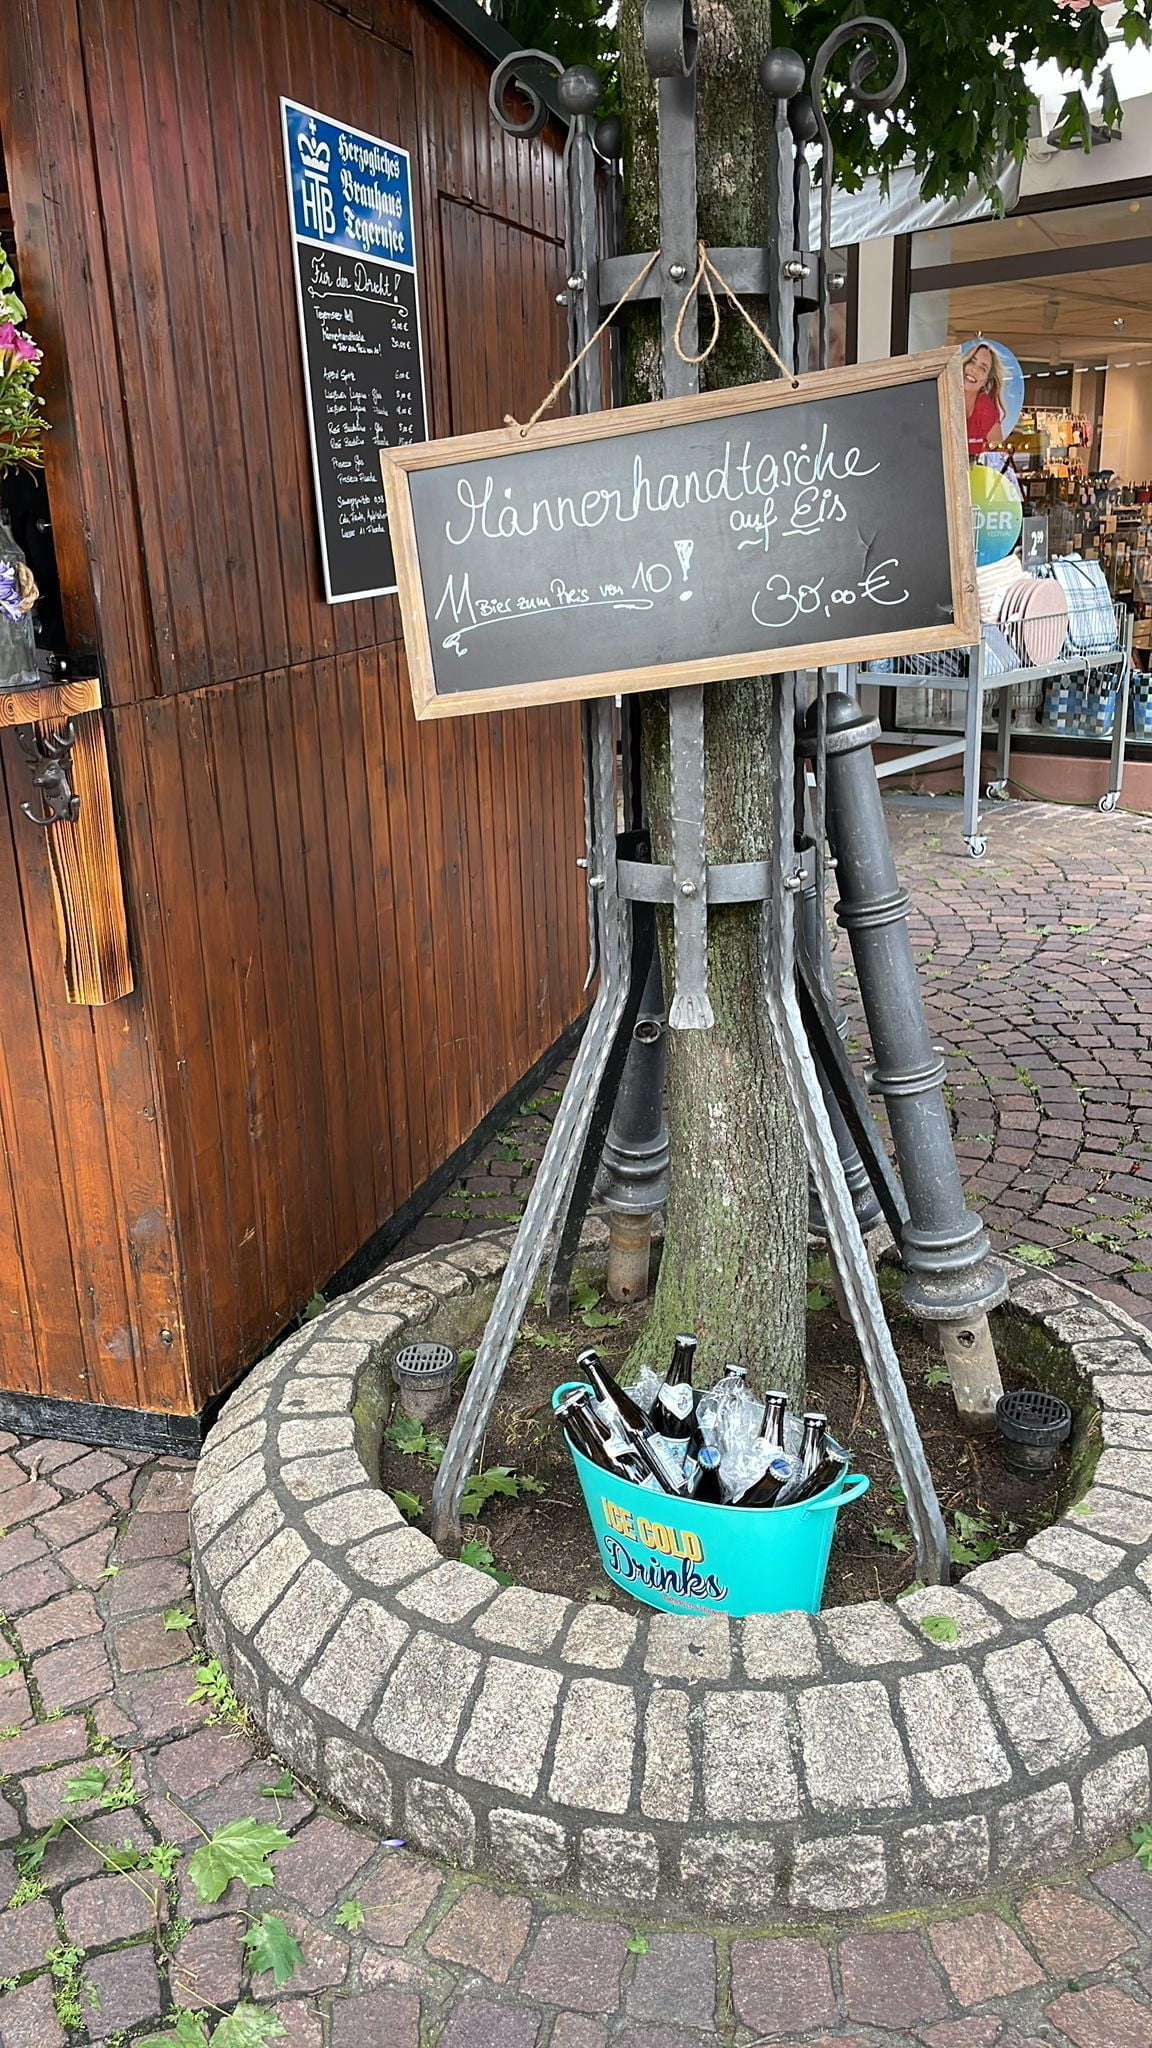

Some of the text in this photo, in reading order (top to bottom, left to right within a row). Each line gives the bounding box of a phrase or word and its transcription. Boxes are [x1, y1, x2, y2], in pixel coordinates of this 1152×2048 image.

[338, 133, 400, 182] Herzogliches
[340, 168, 403, 219] Brauhaus
[343, 205, 405, 260] Tegernsee
[730, 487, 847, 551] auf Eis
[435, 573, 477, 623] 11
[476, 599, 511, 617] Bier
[516, 596, 550, 609] zum
[551, 578, 589, 602] Preis
[599, 584, 623, 597] von
[601, 1496, 705, 1563] ICE COLD
[604, 1535, 728, 1601] Drinks
